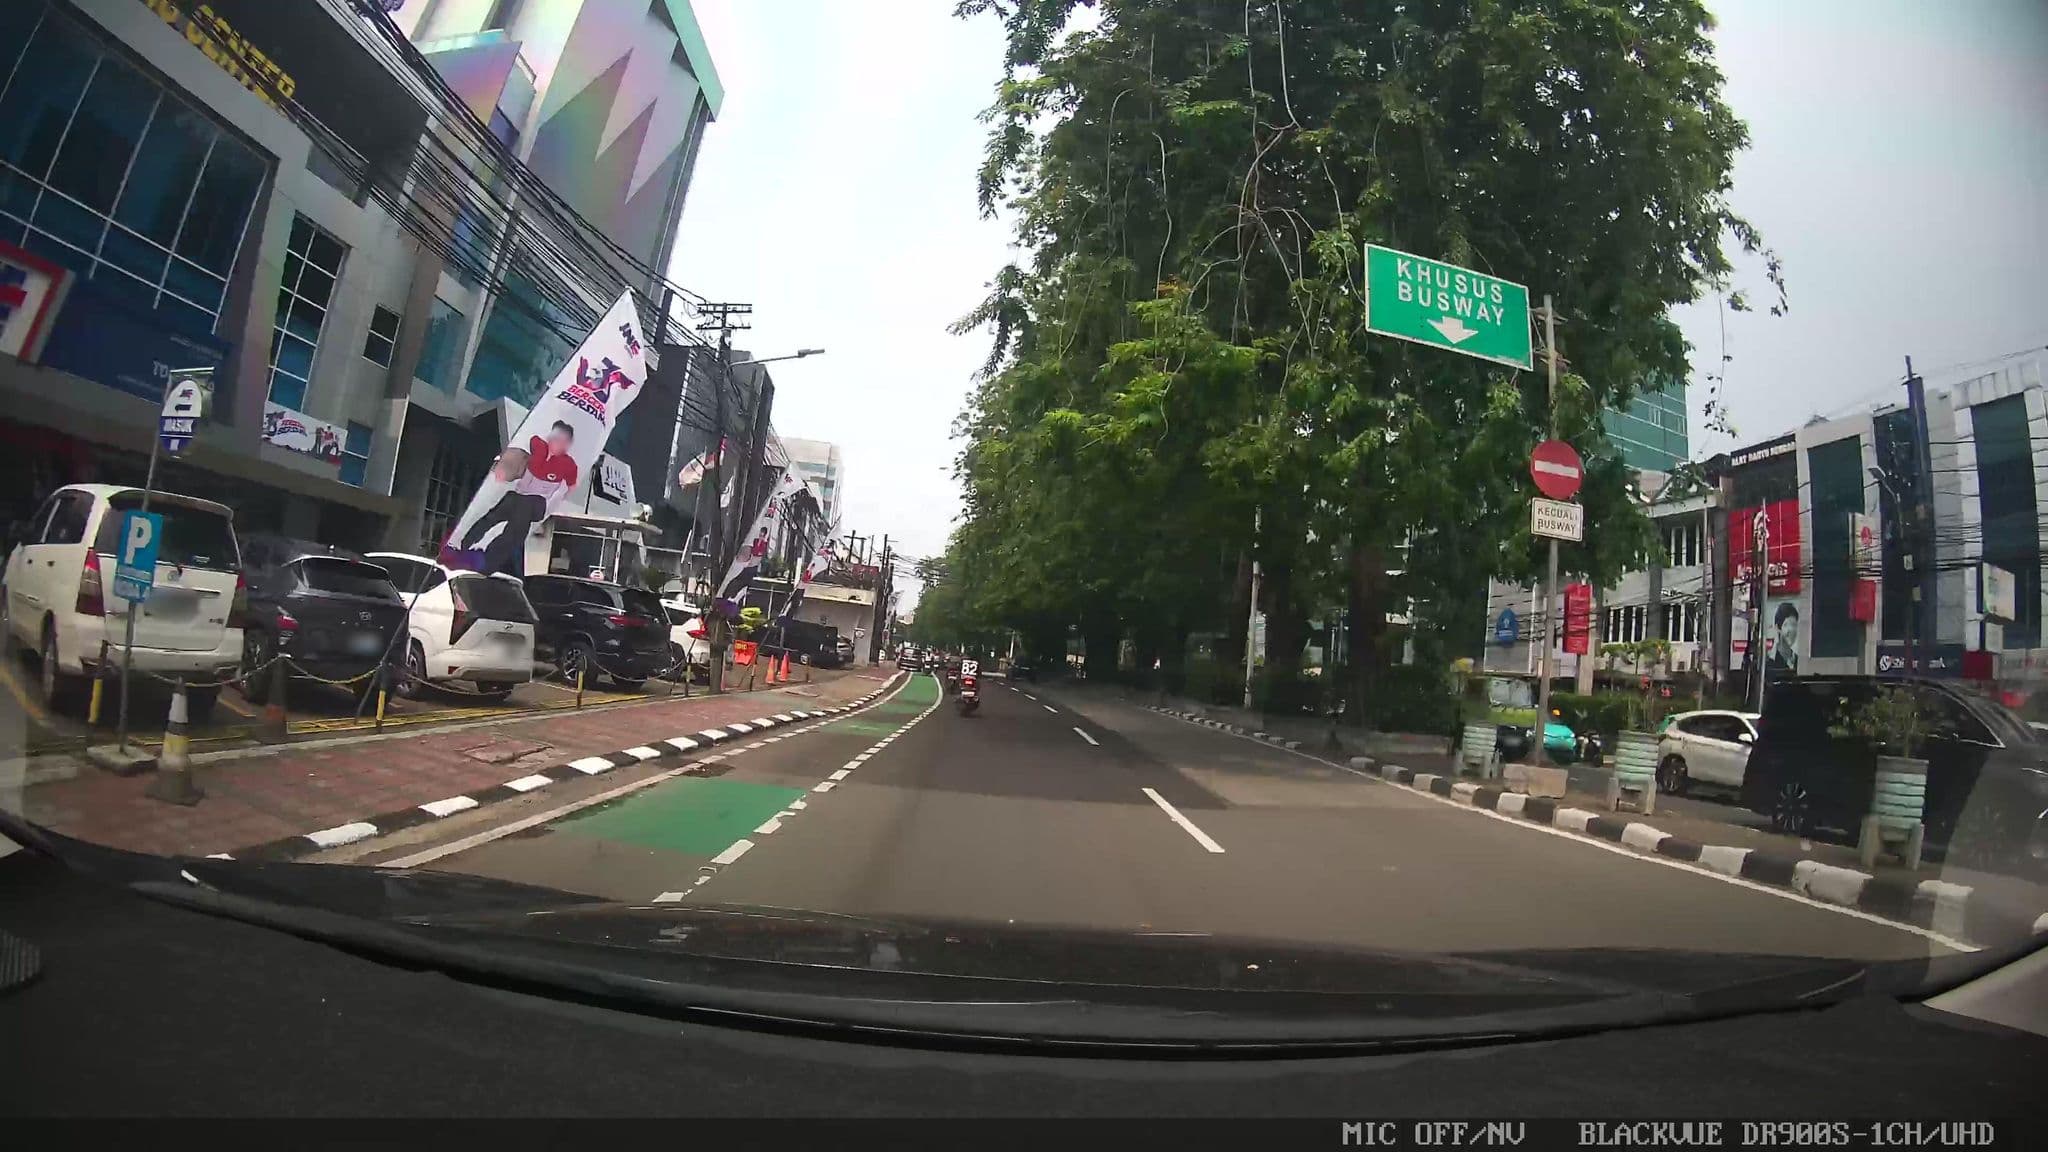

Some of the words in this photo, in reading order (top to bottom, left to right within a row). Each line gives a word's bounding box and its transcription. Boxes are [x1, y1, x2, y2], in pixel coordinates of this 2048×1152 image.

[1397, 257, 1504, 305] KHUSUS
[1397, 281, 1505, 327] BUSWAY
[1537, 506, 1578, 521] KECUALI
[1537, 518, 1577, 536] BUSWAY
[124, 515, 152, 565] P
[961, 662, 978, 676] 82
